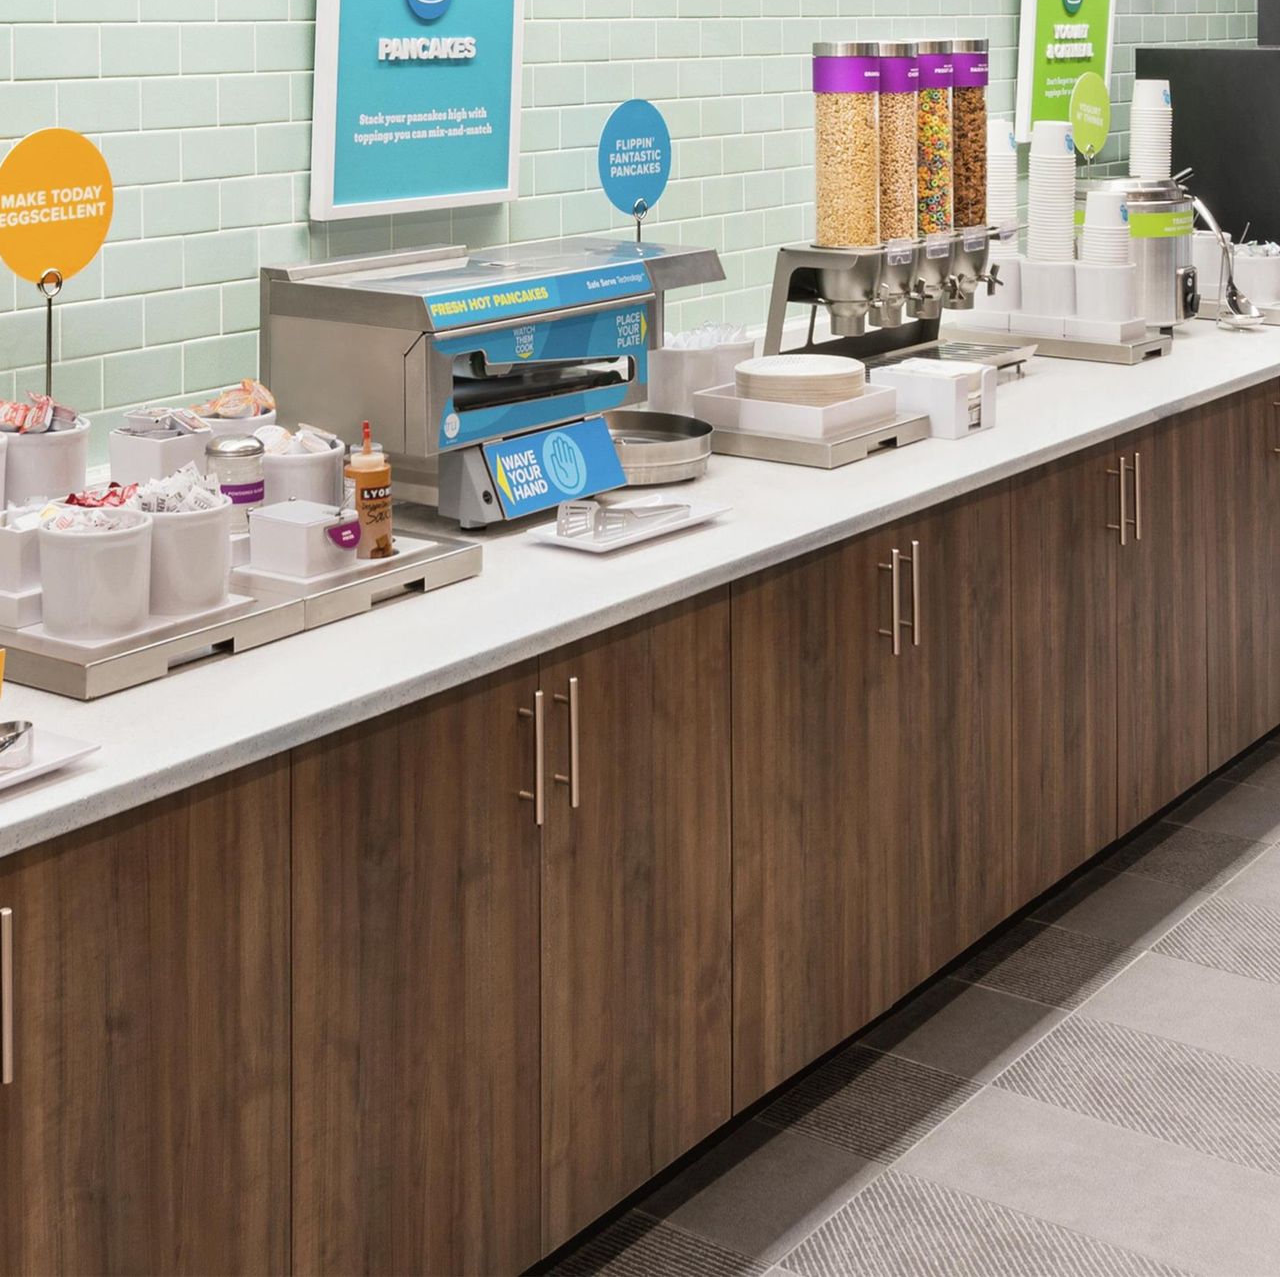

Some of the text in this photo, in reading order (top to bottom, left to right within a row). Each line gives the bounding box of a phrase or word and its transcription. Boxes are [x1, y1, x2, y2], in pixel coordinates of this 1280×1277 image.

[378, 37, 477, 62] PANCAKES
[359, 107, 487, 127] Stack your pancakes high with
[354, 123, 492, 146] toppings you can mix-and-match
[616, 137, 655, 151] FLIPPIN'
[610, 150, 661, 164] FANTASTIC
[611, 163, 661, 178] PANCAKES
[0, 185, 103, 209] MAKE TODAY
[586, 279, 600, 290] Safe
[600, 277, 617, 289] Serve
[430, 287, 549, 317] FRESH HOT PANCAKES
[616, 312, 640, 326] PLACE
[513, 325, 536, 336] WATCH
[617, 324, 640, 337] YOUR
[516, 334, 534, 345] THEM
[617, 335, 640, 348] PLATE
[515, 344, 534, 354] COOK
[501, 450, 537, 471] WAVE
[507, 465, 542, 485] YOUR
[513, 479, 548, 501] HAND
